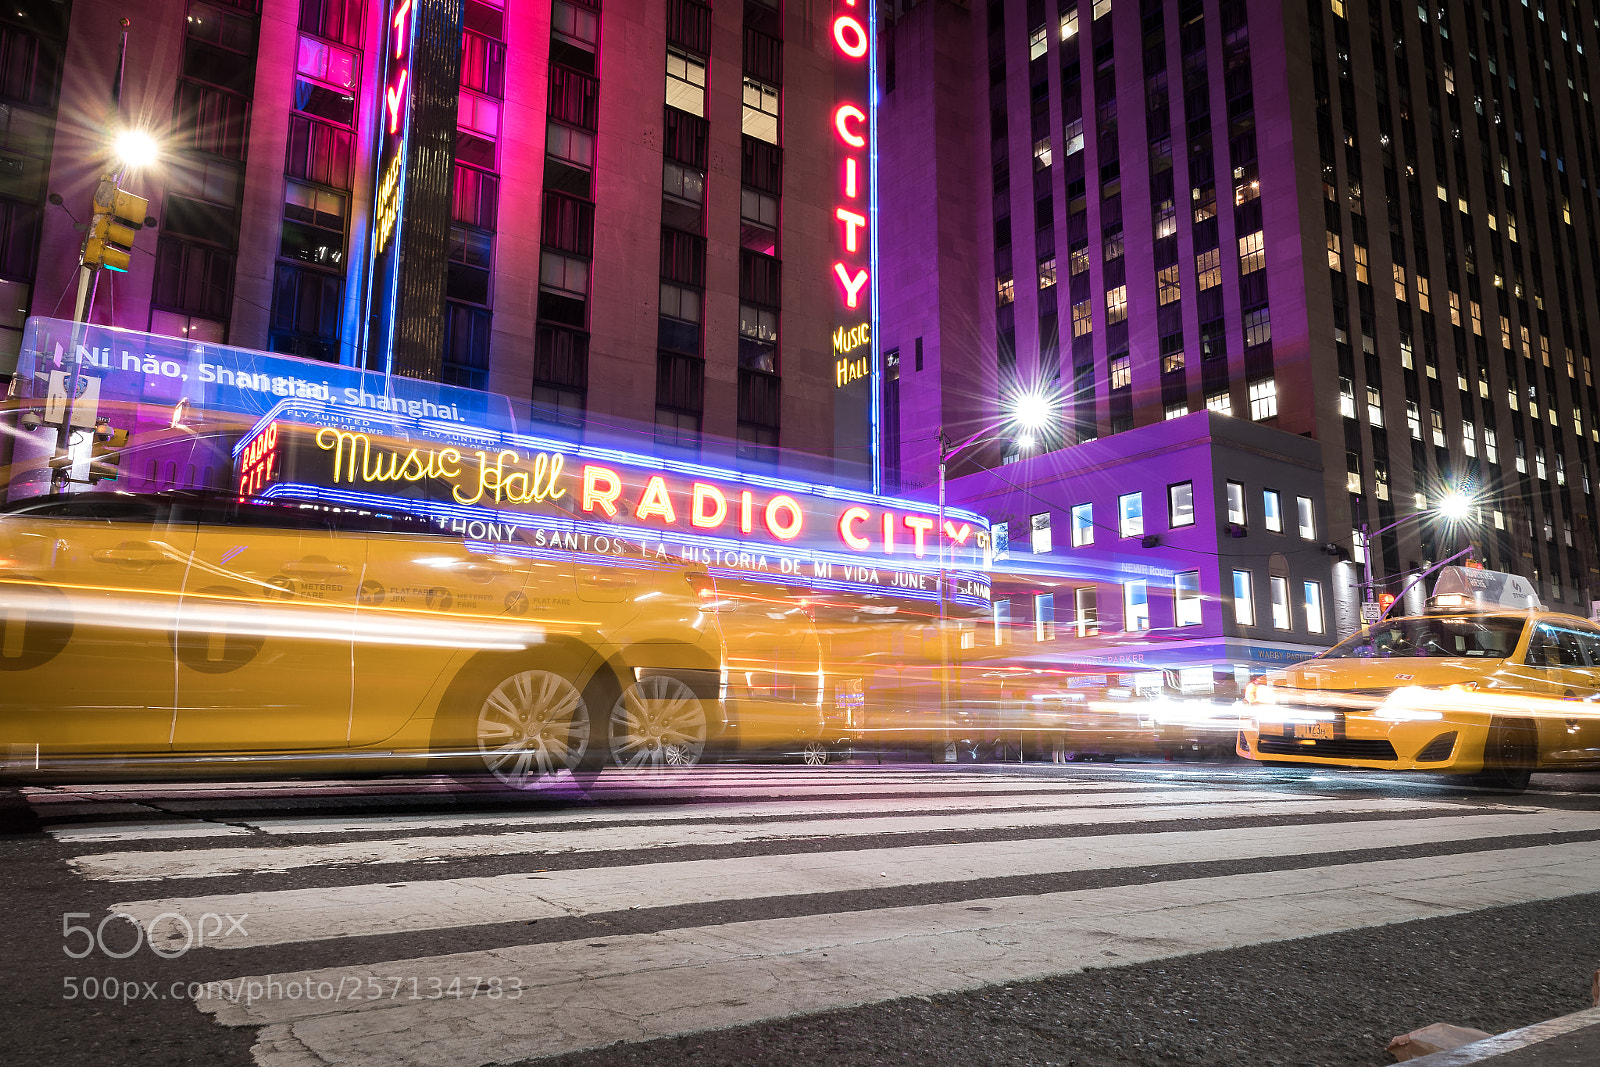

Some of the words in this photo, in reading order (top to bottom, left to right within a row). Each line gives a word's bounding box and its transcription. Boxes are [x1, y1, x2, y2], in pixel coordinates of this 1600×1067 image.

[834, 104, 869, 308] CITY
[286, 409, 310, 418] FLY
[321, 414, 371, 427] UNITED
[422, 430, 441, 438] FLY
[241, 420, 278, 473] RADIO
[315, 427, 462, 485] Music
[452, 449, 567, 505] Hall
[581, 464, 804, 541] RADIO
[838, 506, 971, 560] CITY
[642, 540, 668, 560] LA
[680, 544, 768, 571] HISTORIA
[780, 557, 802, 575] DE
[814, 561, 833, 579] MI
[843, 564, 880, 585] VIDA
[891, 571, 928, 591] JUNE
[300, 583, 343, 592] METERED
[390, 586, 411, 595] FLAT
[412, 588, 434, 596] FARE
[300, 591, 325, 600] FARE
[1107, 653, 1145, 665] PARKER
[1257, 649, 1284, 660] WARBY
